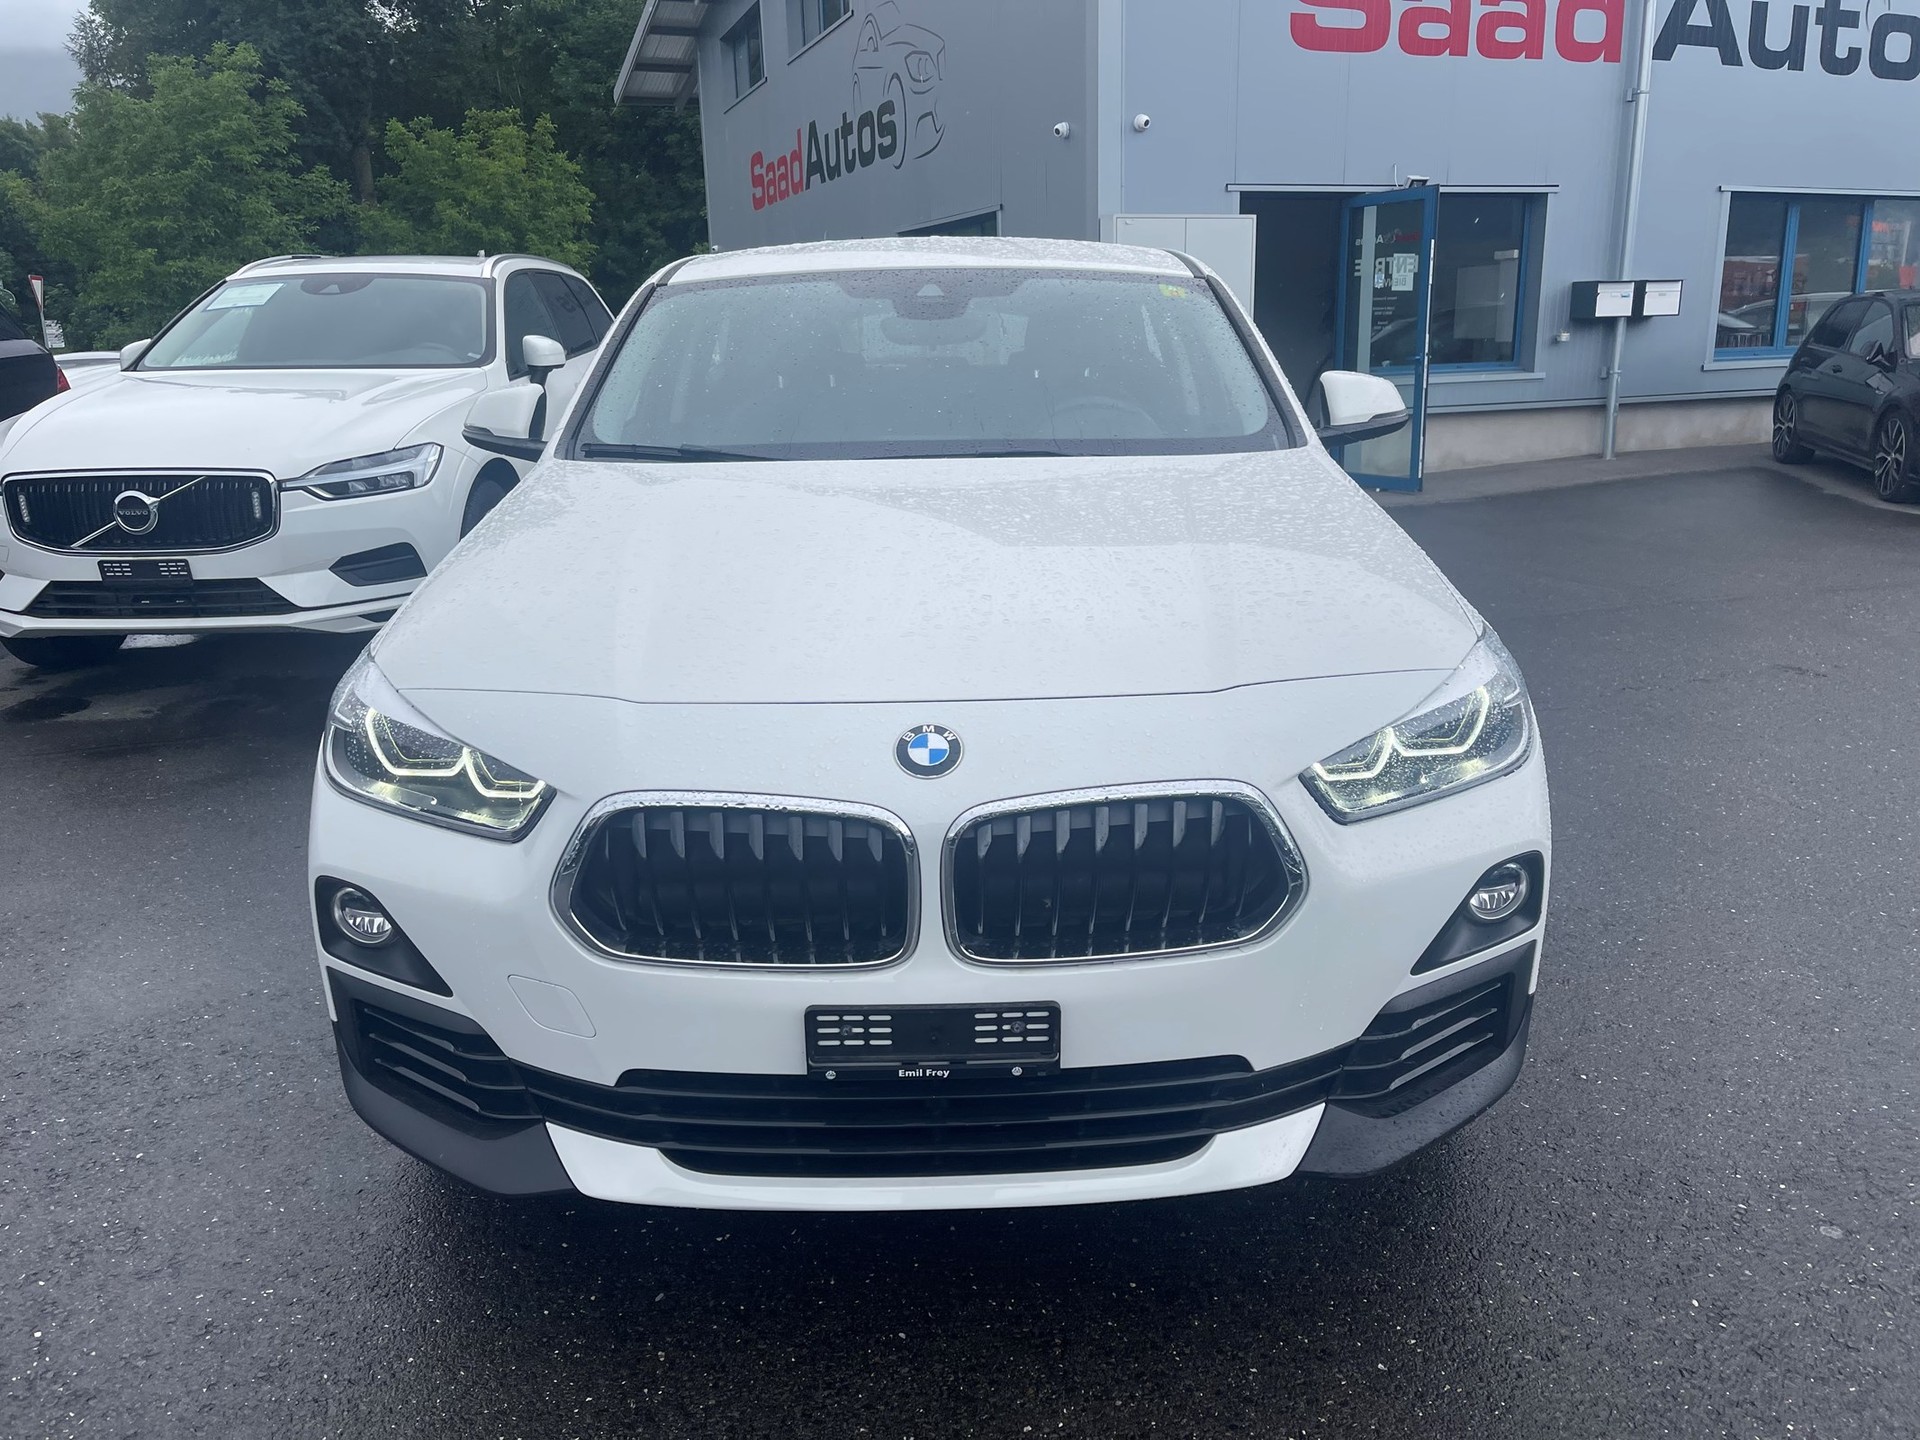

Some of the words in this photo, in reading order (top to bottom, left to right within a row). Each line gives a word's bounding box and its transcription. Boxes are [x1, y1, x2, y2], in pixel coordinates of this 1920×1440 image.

[902, 725, 957, 742] BMW
[898, 1068, 923, 1078] Emil
[926, 1068, 950, 1079] Frey
